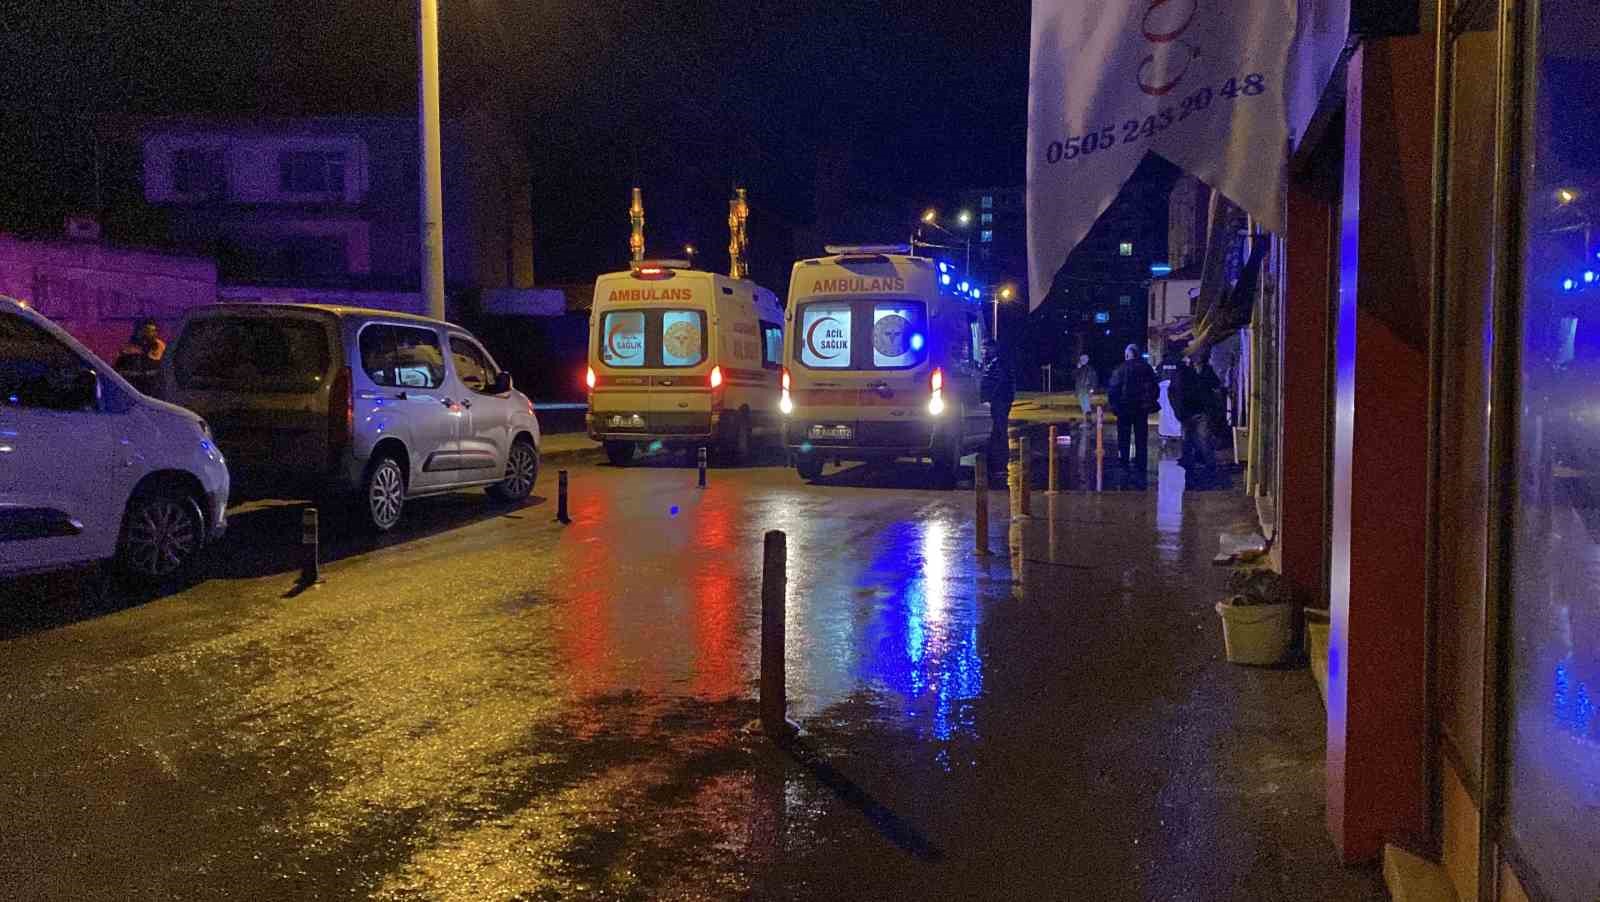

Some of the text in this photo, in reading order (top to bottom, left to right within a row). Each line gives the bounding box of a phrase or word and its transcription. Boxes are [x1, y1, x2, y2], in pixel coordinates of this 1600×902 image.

[1046, 73, 1265, 164] 0505 243 20 48
[812, 277, 905, 293] AMBULANS
[608, 288, 692, 302] AMBULANS
[826, 328, 844, 338] ACİL
[821, 339, 848, 349] SAĞLIK
